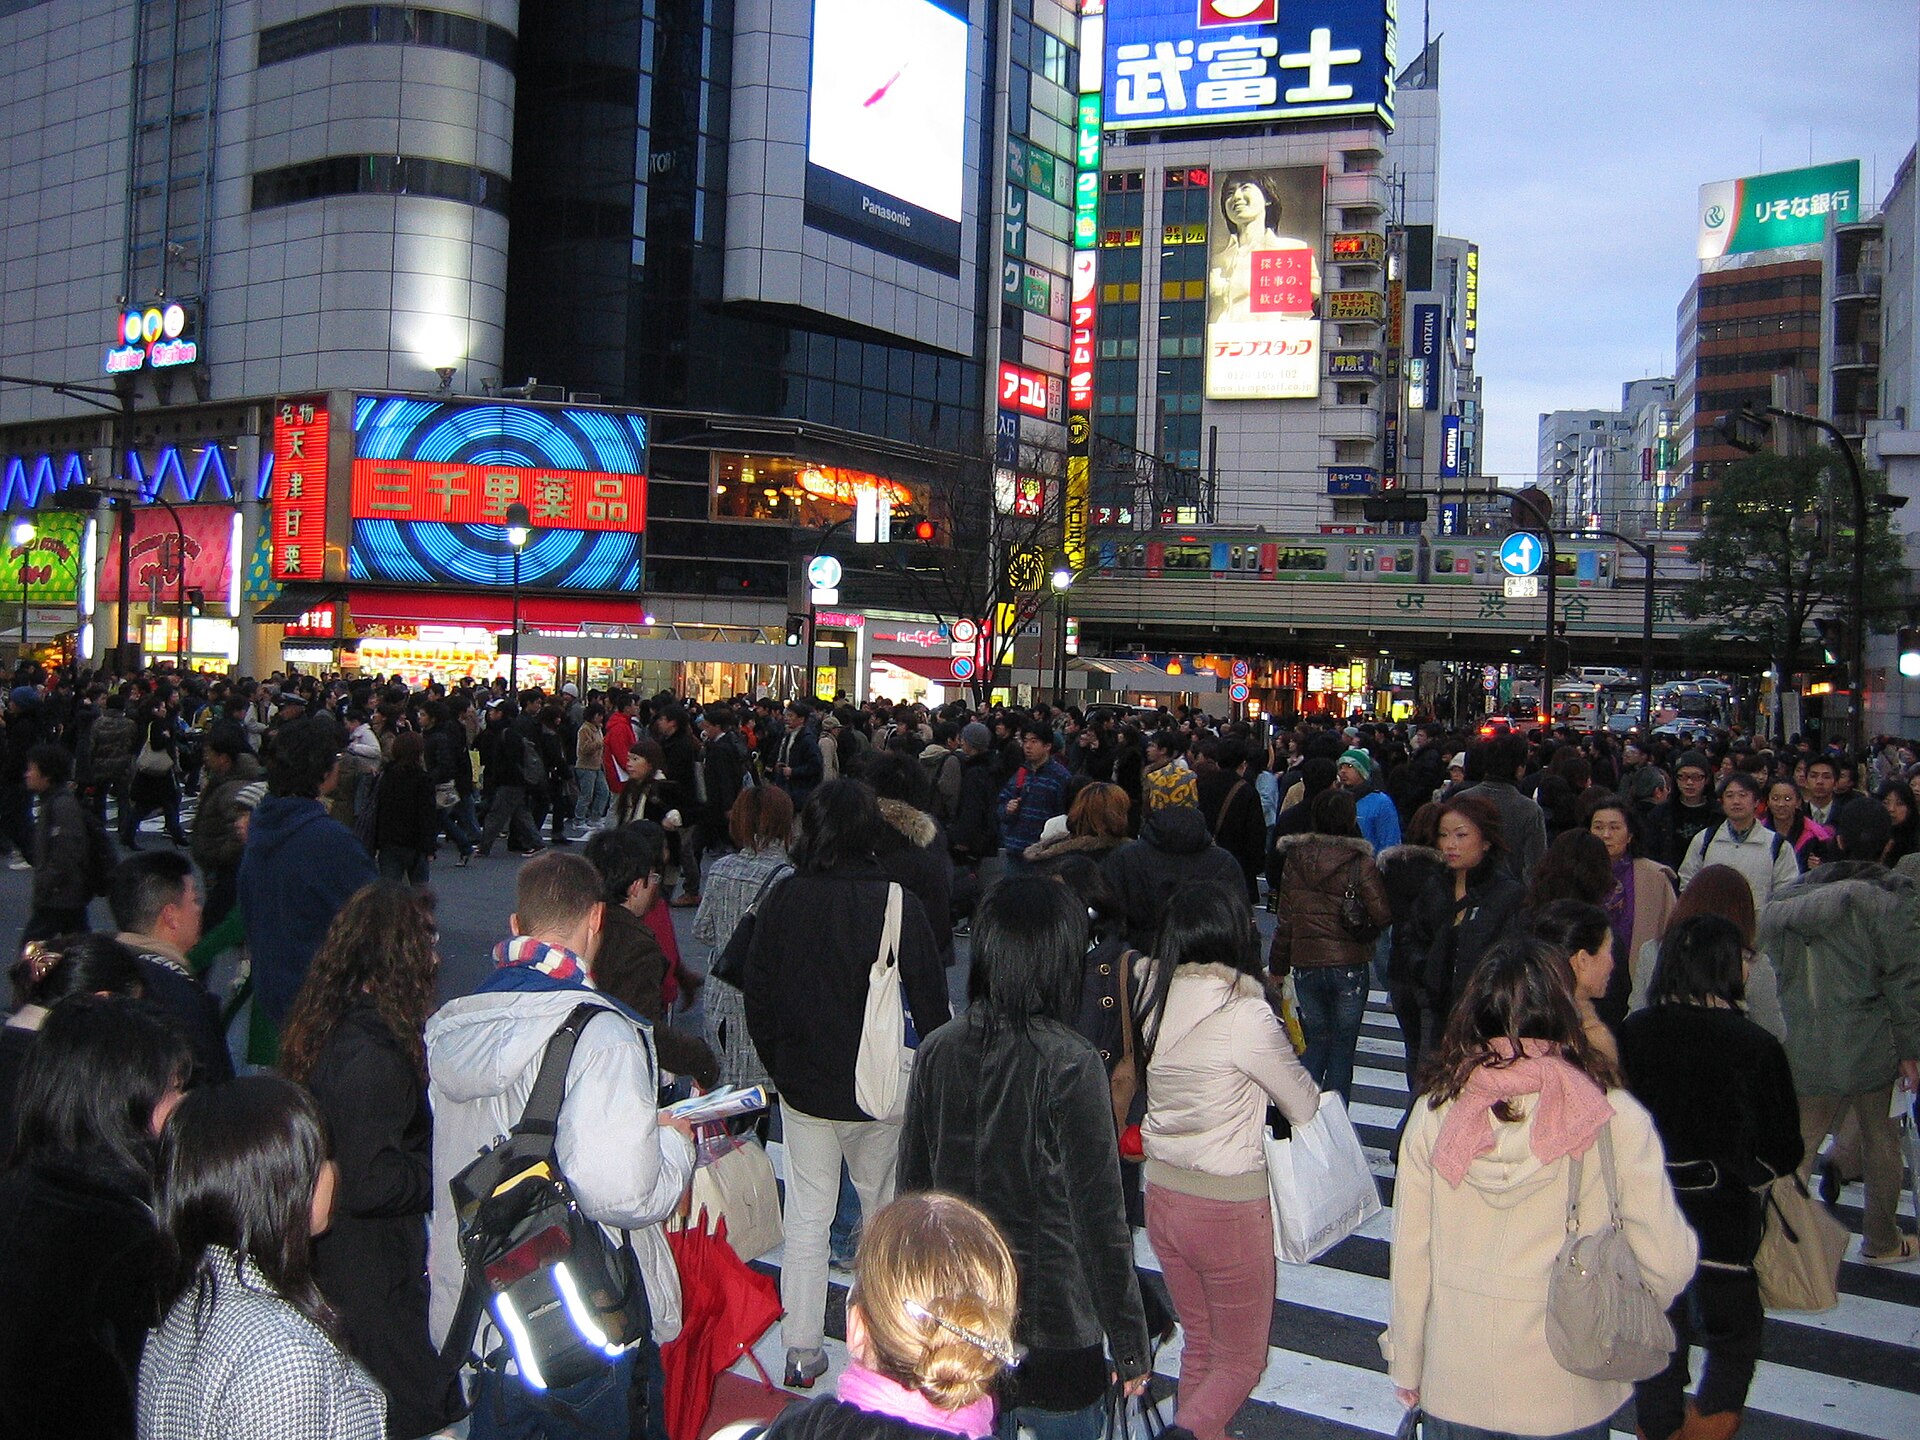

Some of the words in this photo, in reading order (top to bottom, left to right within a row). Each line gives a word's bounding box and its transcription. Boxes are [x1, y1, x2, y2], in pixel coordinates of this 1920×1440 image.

[1116, 28, 1361, 115] 武富士
[1078, 128, 1098, 191] レイク
[862, 195, 911, 227] Panasonic
[1755, 190, 1850, 223] りそな銀行
[1005, 185, 1021, 292] レイク
[1260, 258, 1302, 269] 探そう、
[1260, 275, 1303, 287] 仕事の、
[1074, 307, 1092, 364] アコム
[1214, 339, 1313, 358] テンプスタッフ
[1423, 312, 1434, 355] MIZUHO
[106, 346, 145, 373] Junior
[152, 339, 197, 367] Station
[1003, 372, 1046, 409] アコム
[281, 403, 316, 425] 名物
[1446, 427, 1457, 468] MIZUHO
[283, 431, 305, 573] 天津甘栗
[369, 466, 628, 523] 三千里薬品
[1396, 593, 1425, 609] JR
